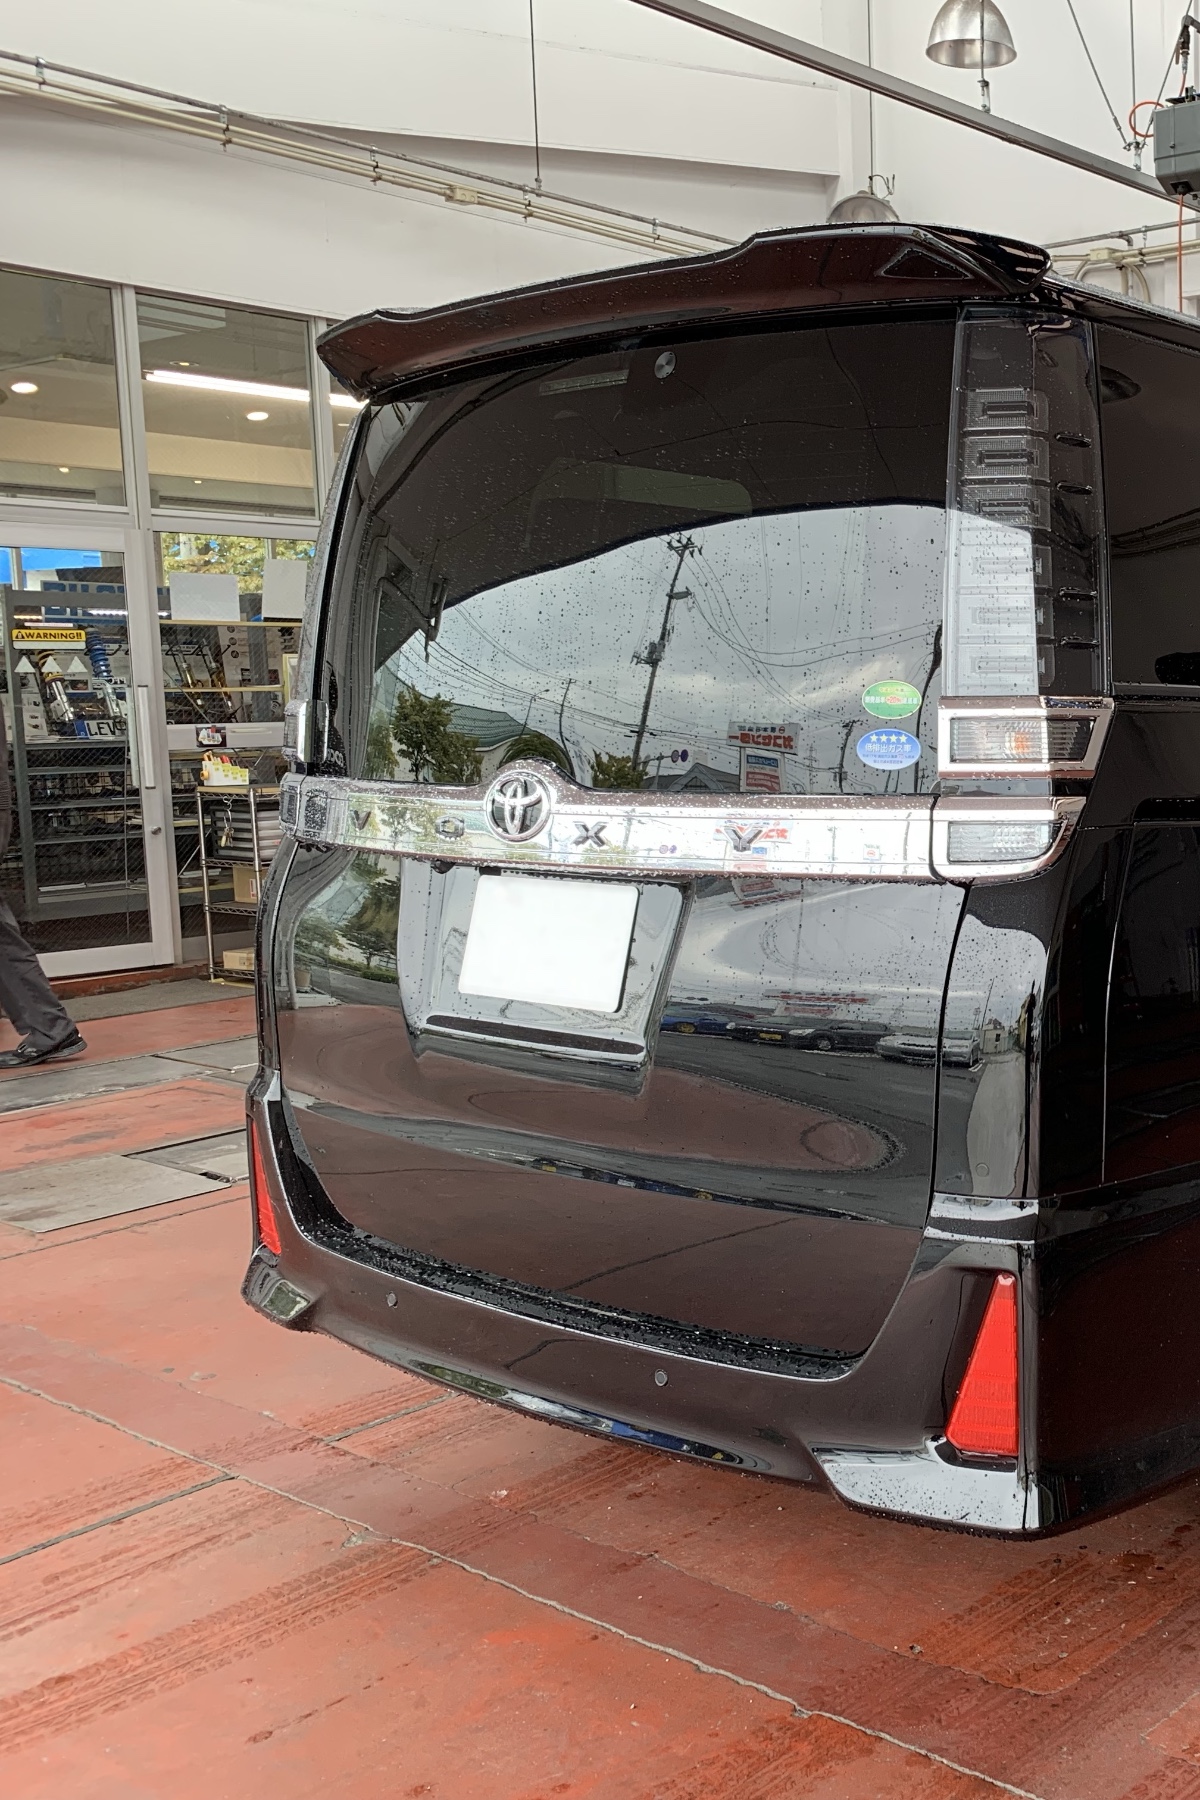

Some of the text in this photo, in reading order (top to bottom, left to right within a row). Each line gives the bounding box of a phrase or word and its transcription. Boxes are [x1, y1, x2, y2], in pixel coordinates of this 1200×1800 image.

[25, 632, 82, 640] WARNING!!
[865, 743, 912, 753] 低排出ガス車
